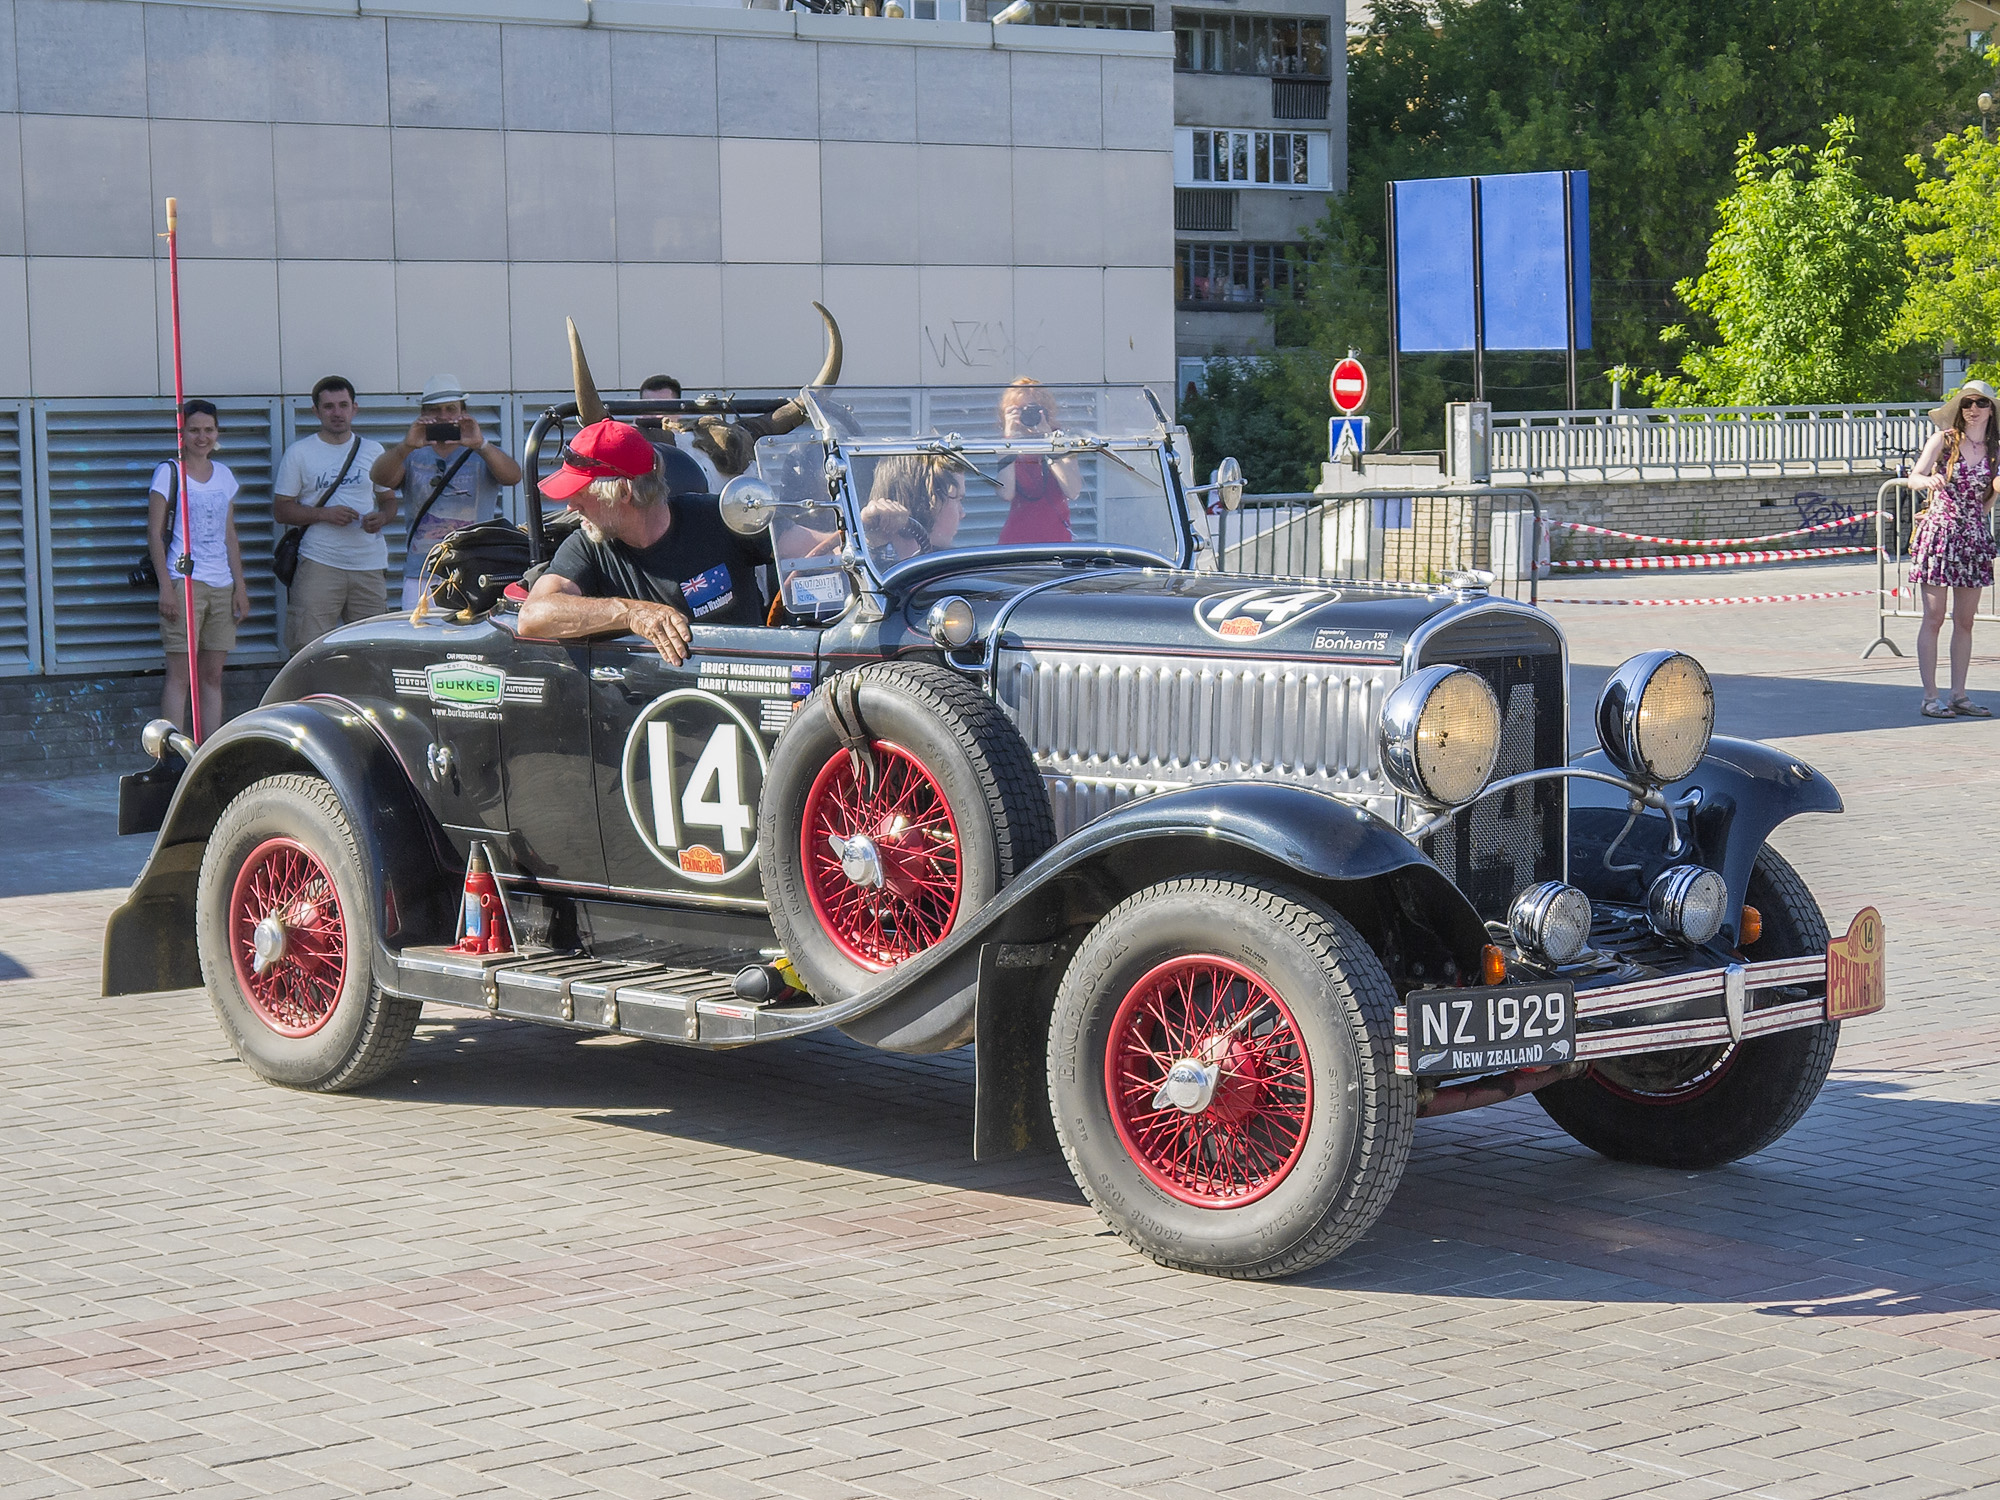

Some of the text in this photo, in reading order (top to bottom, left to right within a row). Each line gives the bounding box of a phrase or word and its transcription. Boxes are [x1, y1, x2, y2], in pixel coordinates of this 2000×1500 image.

[794, 577, 830, 590] 05/07/2017
[1207, 589, 1330, 622] 14
[1314, 636, 1386, 651] Bonhams
[394, 677, 426, 687] CUSTOM
[700, 661, 789, 678] BRUCE WASHINGTON
[436, 677, 495, 692] BURKES
[505, 685, 543, 694] AUTOBODY
[697, 677, 788, 695] HARRY WASHINGTON
[431, 708, 503, 721] www.burkesmetal.com
[647, 721, 750, 852] 14
[680, 854, 722, 874] PEKING PARIS
[781, 855, 801, 917] RADIAL
[1864, 921, 1873, 949] 14
[1830, 949, 1871, 1012] PEKING
[1056, 932, 1130, 1084] EXCELSIOR
[1421, 992, 1566, 1046] NZ 1929
[1452, 1044, 1544, 1069] NEW ZEALAND
[1328, 1067, 1340, 1124] STAHL
[1255, 1201, 1305, 1240] RADIAL
